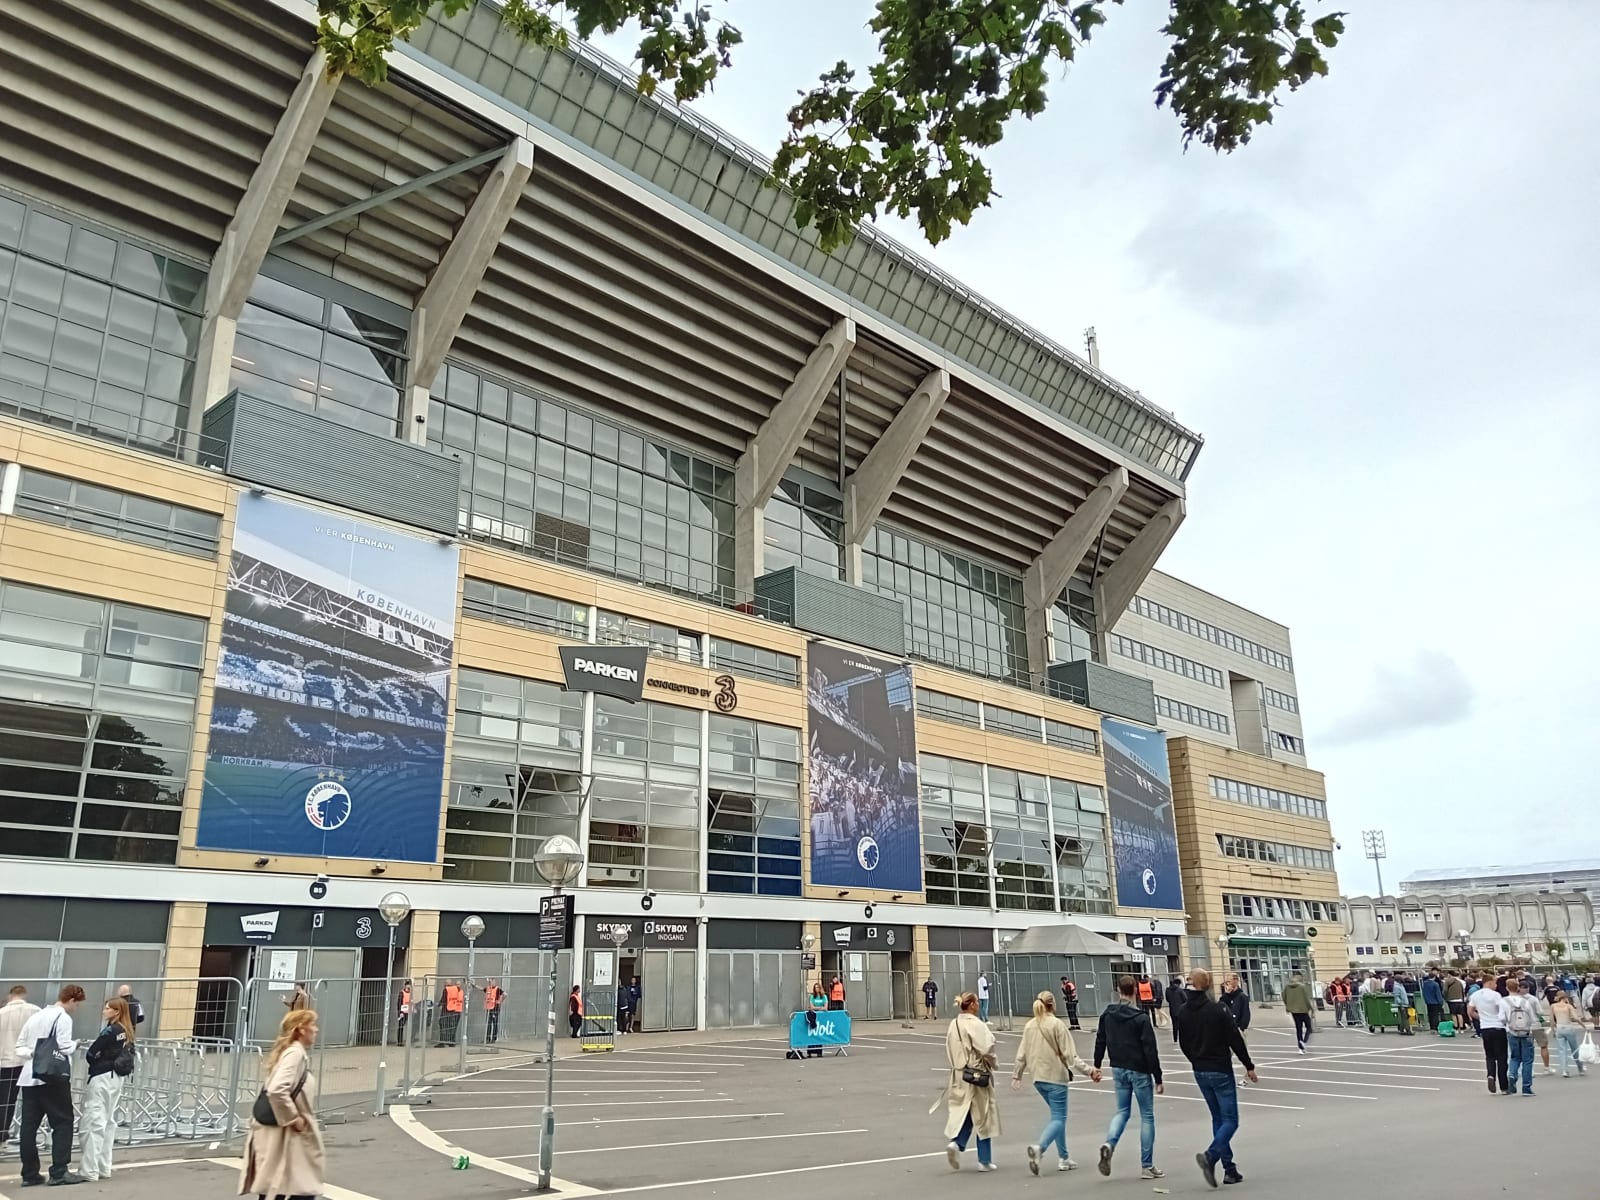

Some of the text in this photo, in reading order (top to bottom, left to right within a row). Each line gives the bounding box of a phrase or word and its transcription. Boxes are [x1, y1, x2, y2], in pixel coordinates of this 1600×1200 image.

[326, 528, 338, 537] ER
[341, 532, 396, 552] KØBENHAVN
[356, 588, 437, 630] KØBENHAVN
[574, 657, 638, 682] PARKEN
[647, 675, 737, 712] CONNECTED BY 3
[223, 756, 264, 768] HORKRAM
[246, 919, 274, 927] PARKEN
[356, 917, 372, 939] 3
[655, 924, 688, 933] SKYBOX
[807, 1019, 836, 1037] Wolt
